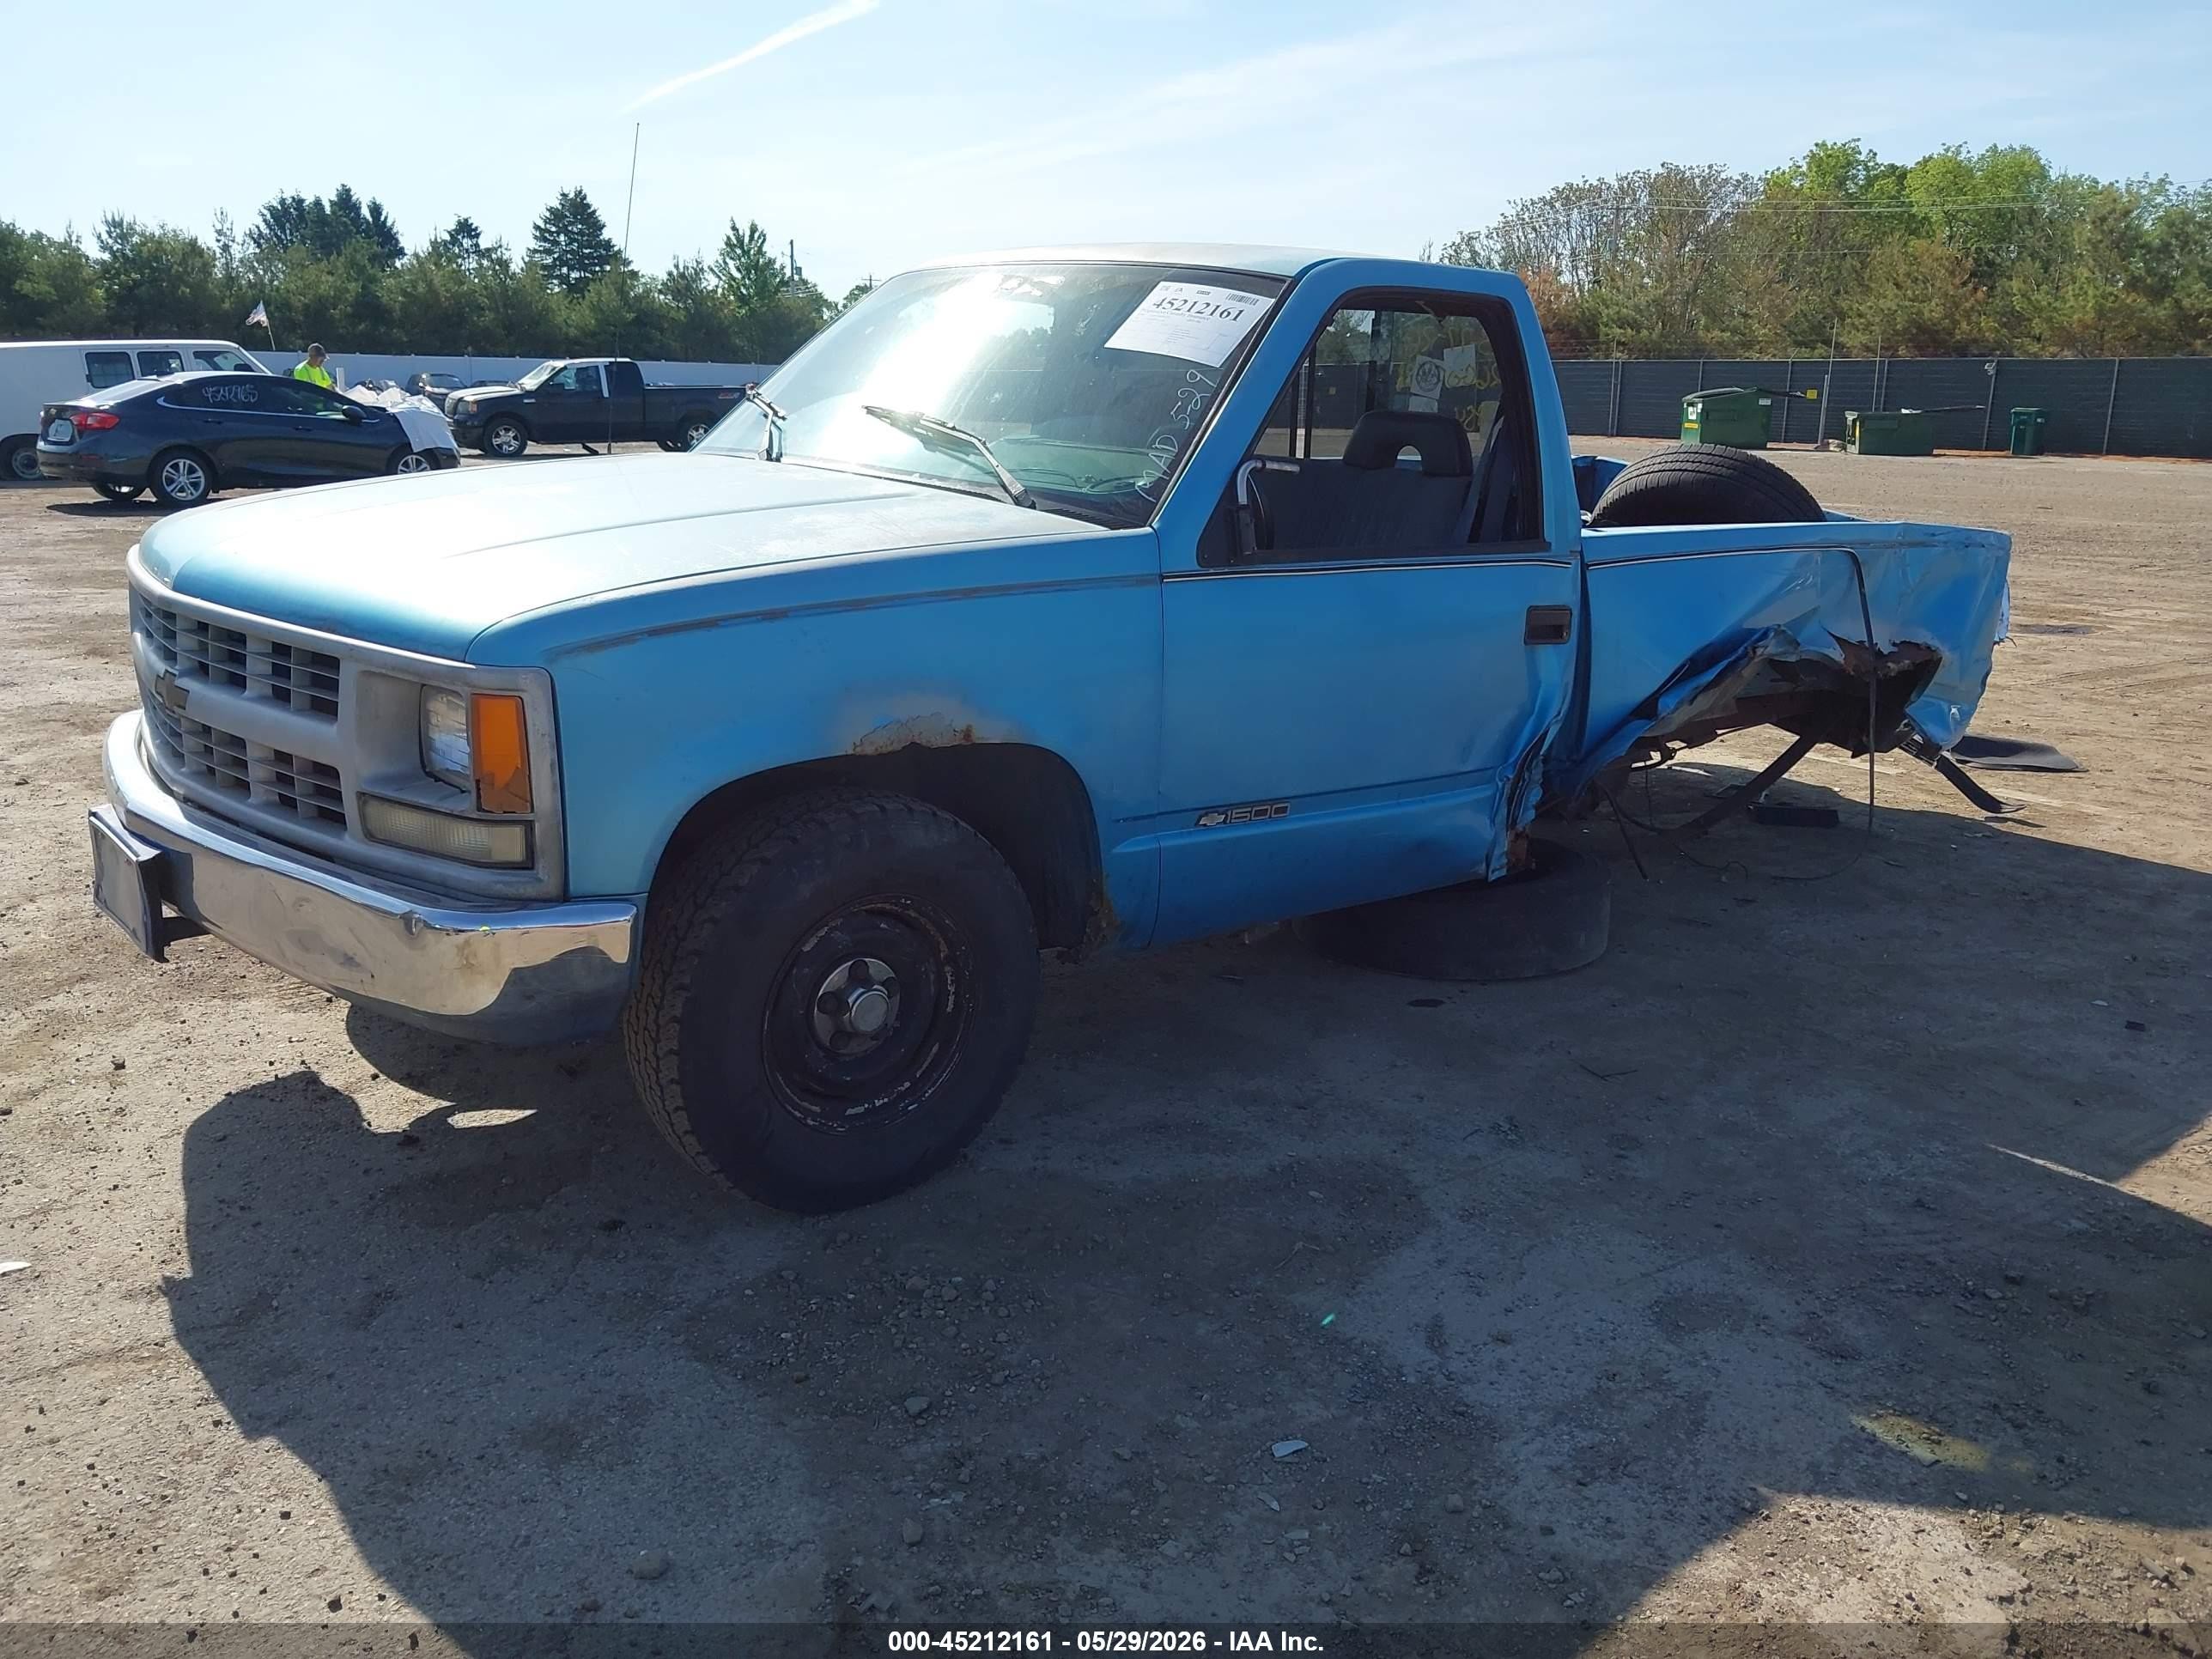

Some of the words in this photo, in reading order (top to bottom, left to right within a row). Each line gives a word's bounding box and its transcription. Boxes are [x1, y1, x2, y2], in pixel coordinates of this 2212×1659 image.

[1152, 297, 1245, 322] 45212161
[1170, 369, 1217, 430] 5-29
[1226, 802, 1291, 824] 1500
